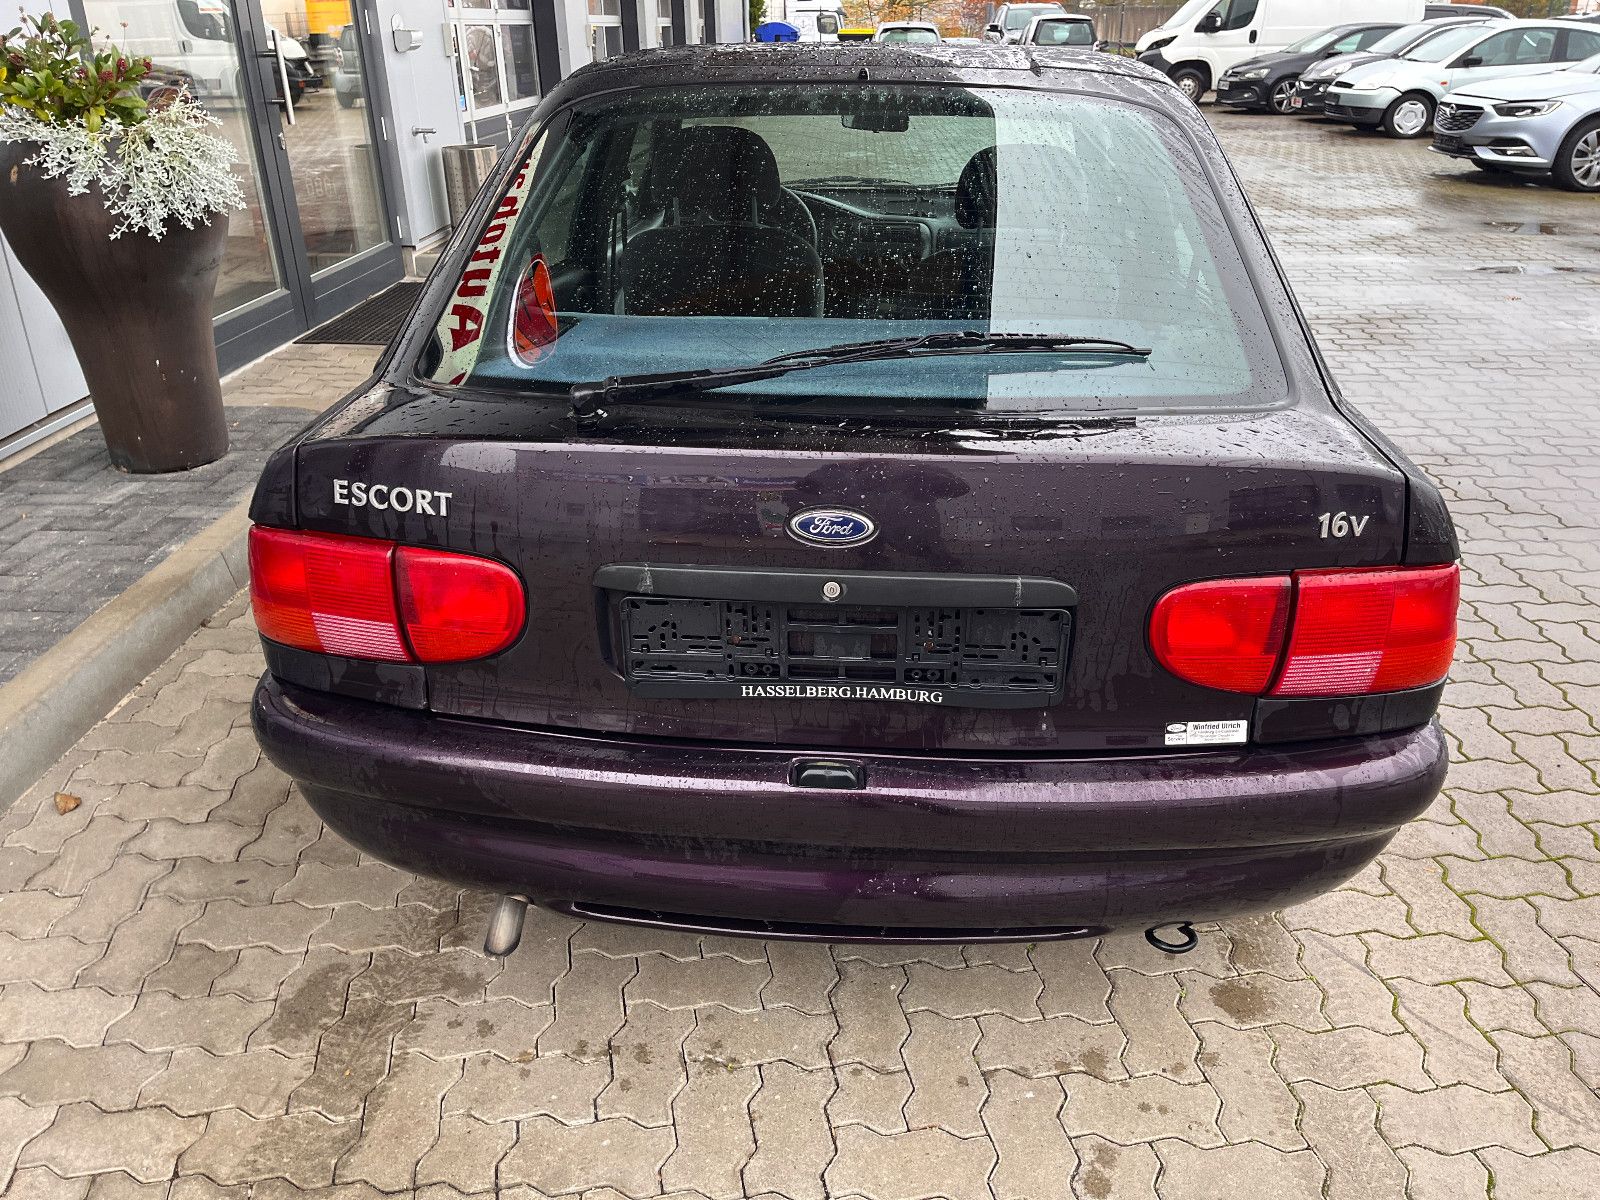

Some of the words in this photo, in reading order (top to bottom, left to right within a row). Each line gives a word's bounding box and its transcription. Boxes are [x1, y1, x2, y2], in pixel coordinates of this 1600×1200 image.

[333, 478, 453, 517] ESCORT
[809, 516, 854, 535] Ford
[741, 685, 943, 703] HASSELBERG.HAMBURG
[1192, 723, 1220, 731] Winfried
[1221, 722, 1241, 730] Ulrich
